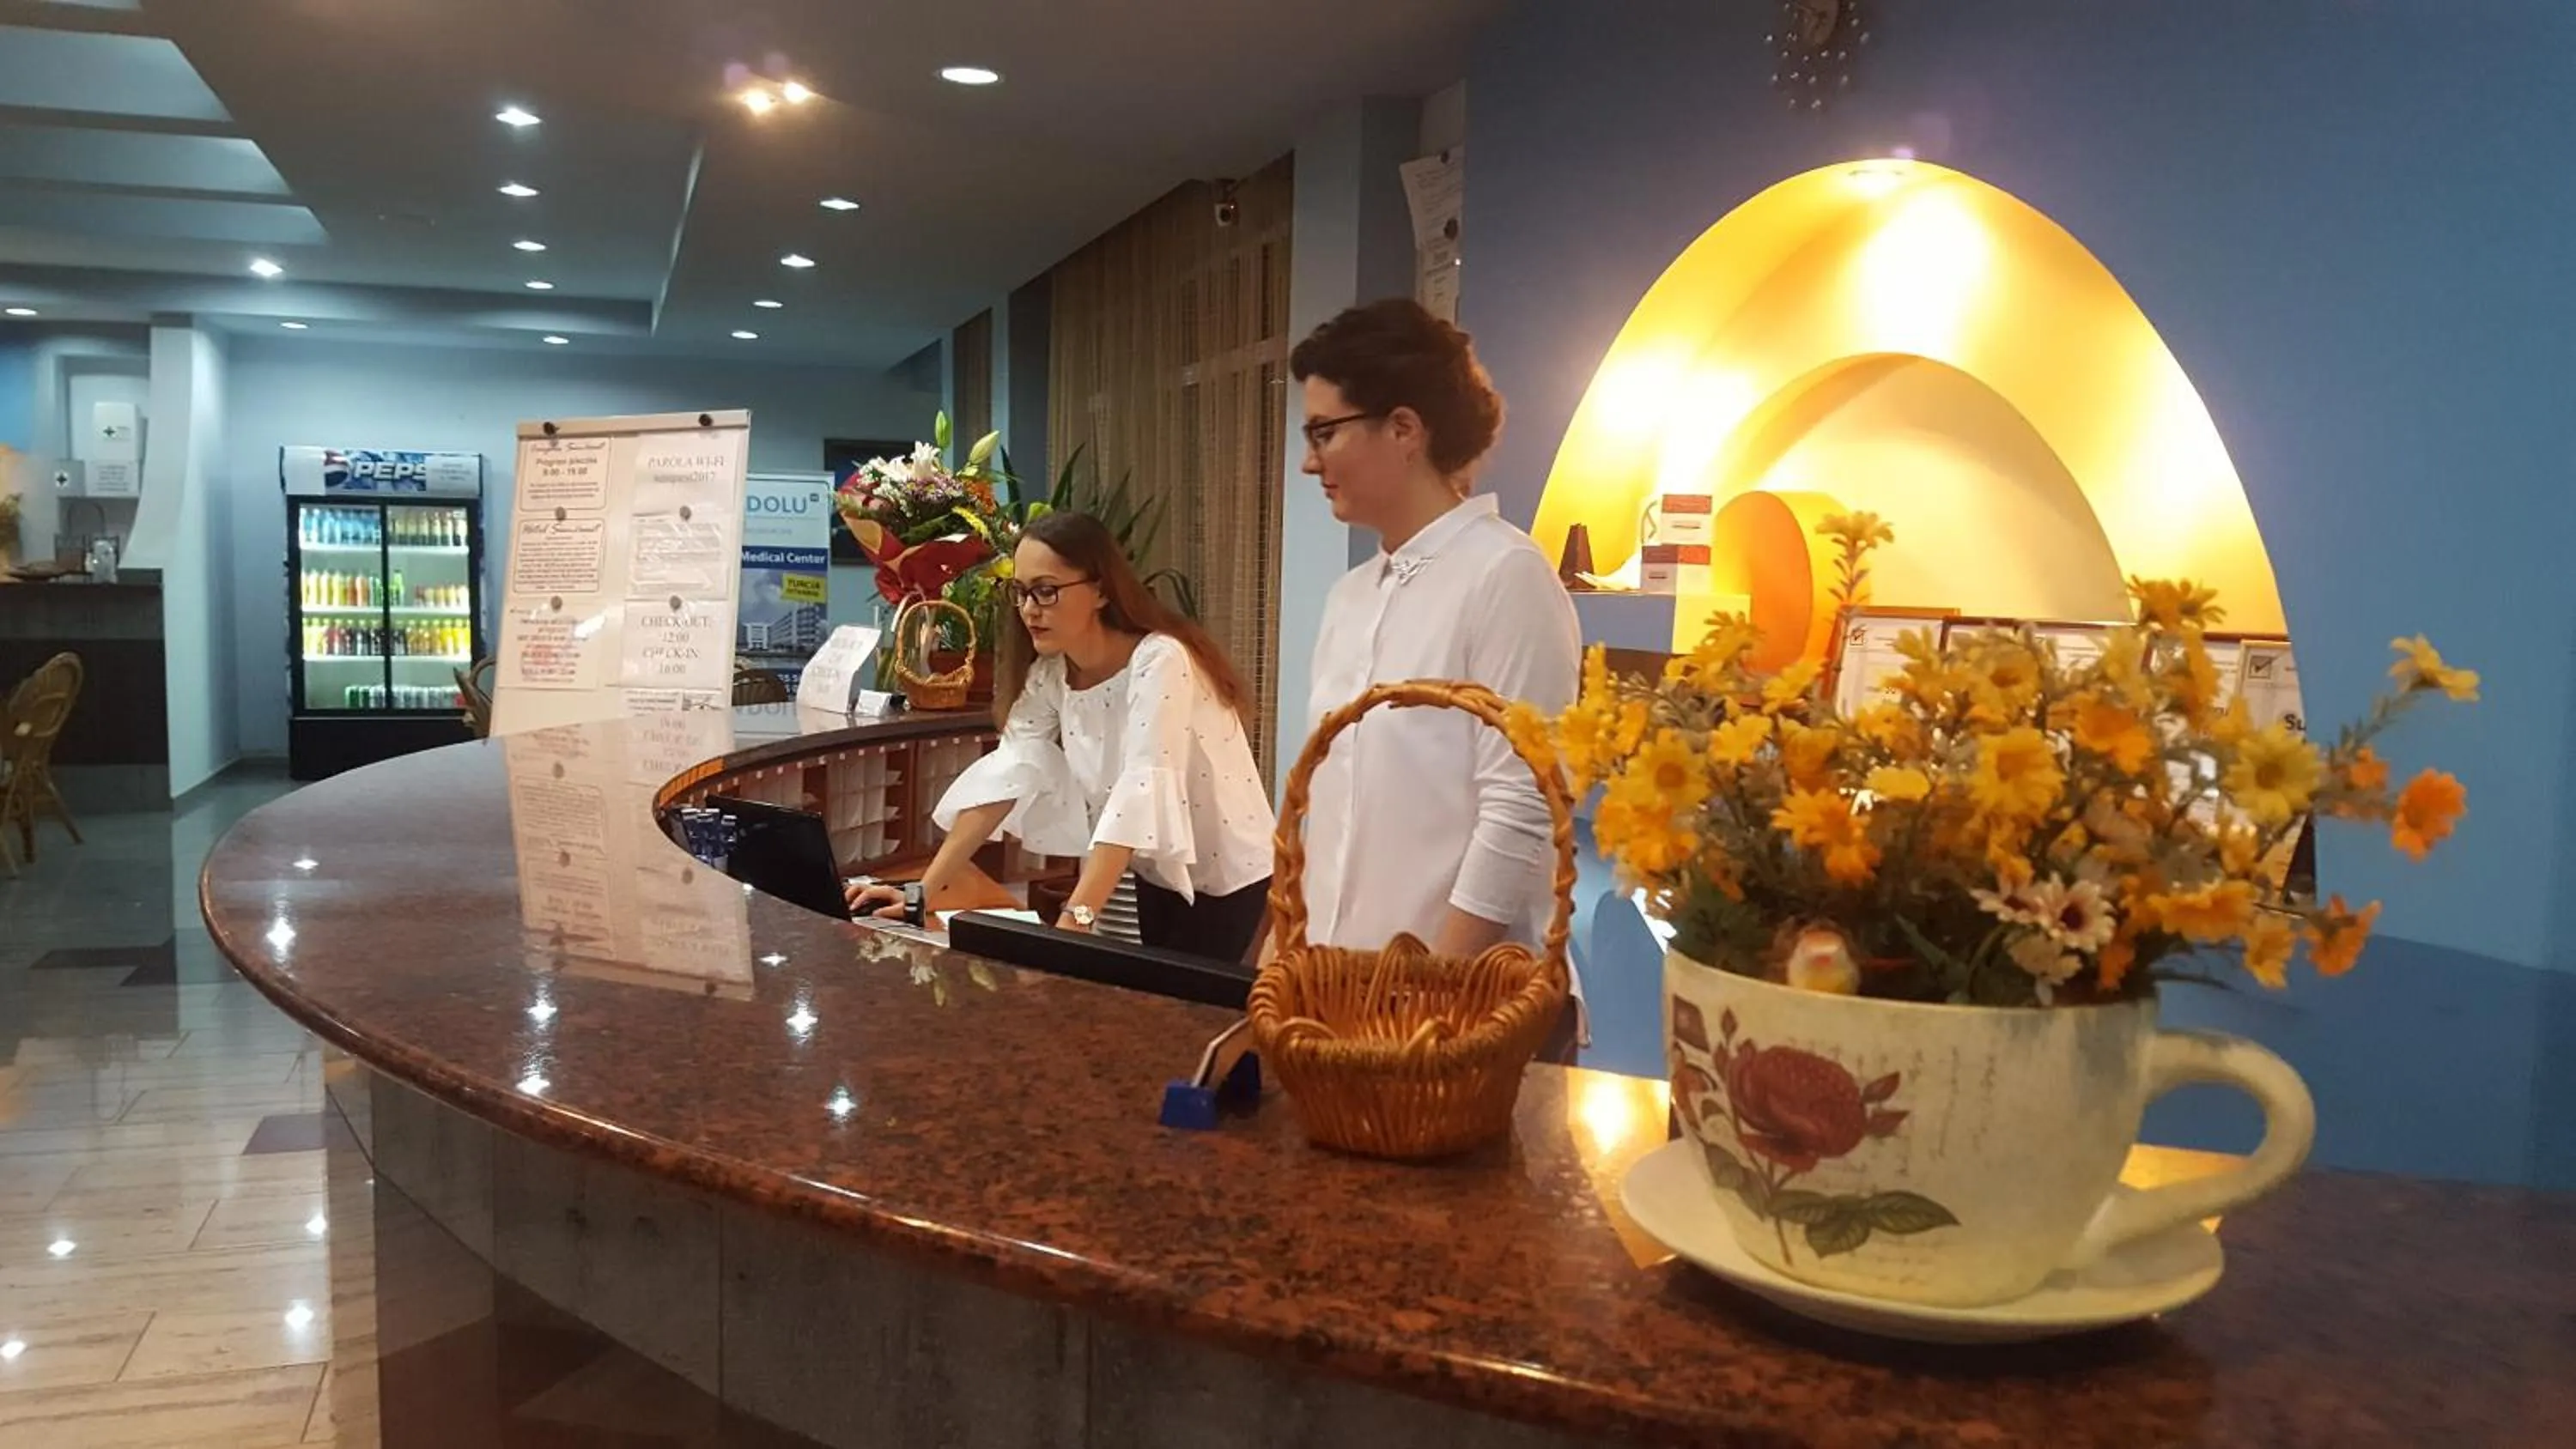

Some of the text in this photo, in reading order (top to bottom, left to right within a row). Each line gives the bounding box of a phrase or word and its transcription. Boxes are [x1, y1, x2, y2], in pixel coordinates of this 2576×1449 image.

[354, 461, 428, 480] PEPS
[746, 494, 807, 514] DOLU
[741, 550, 826, 564] Medical Center
